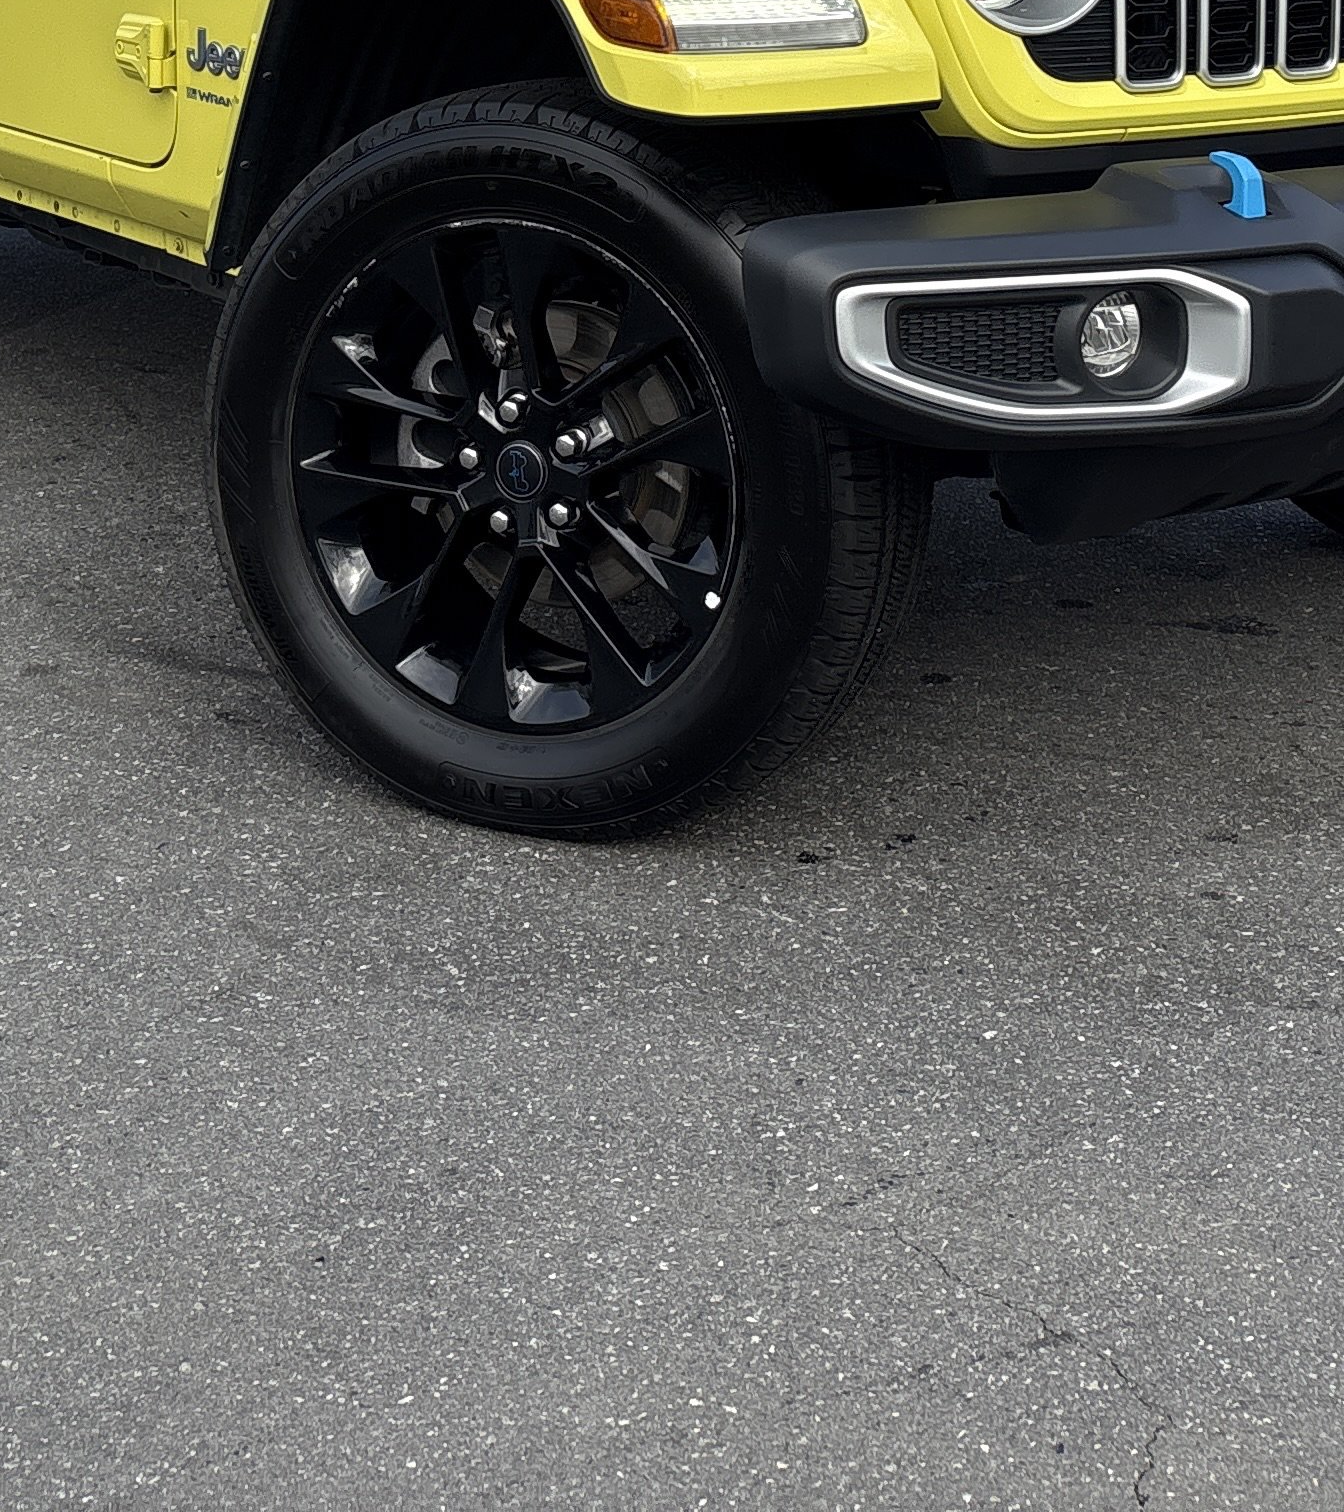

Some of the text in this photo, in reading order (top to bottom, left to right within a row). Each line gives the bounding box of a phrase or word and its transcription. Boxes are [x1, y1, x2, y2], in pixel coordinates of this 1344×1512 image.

[186, 26, 246, 81] Jee
[197, 88, 235, 109] WRAN
[462, 763, 654, 809] NEXEN
